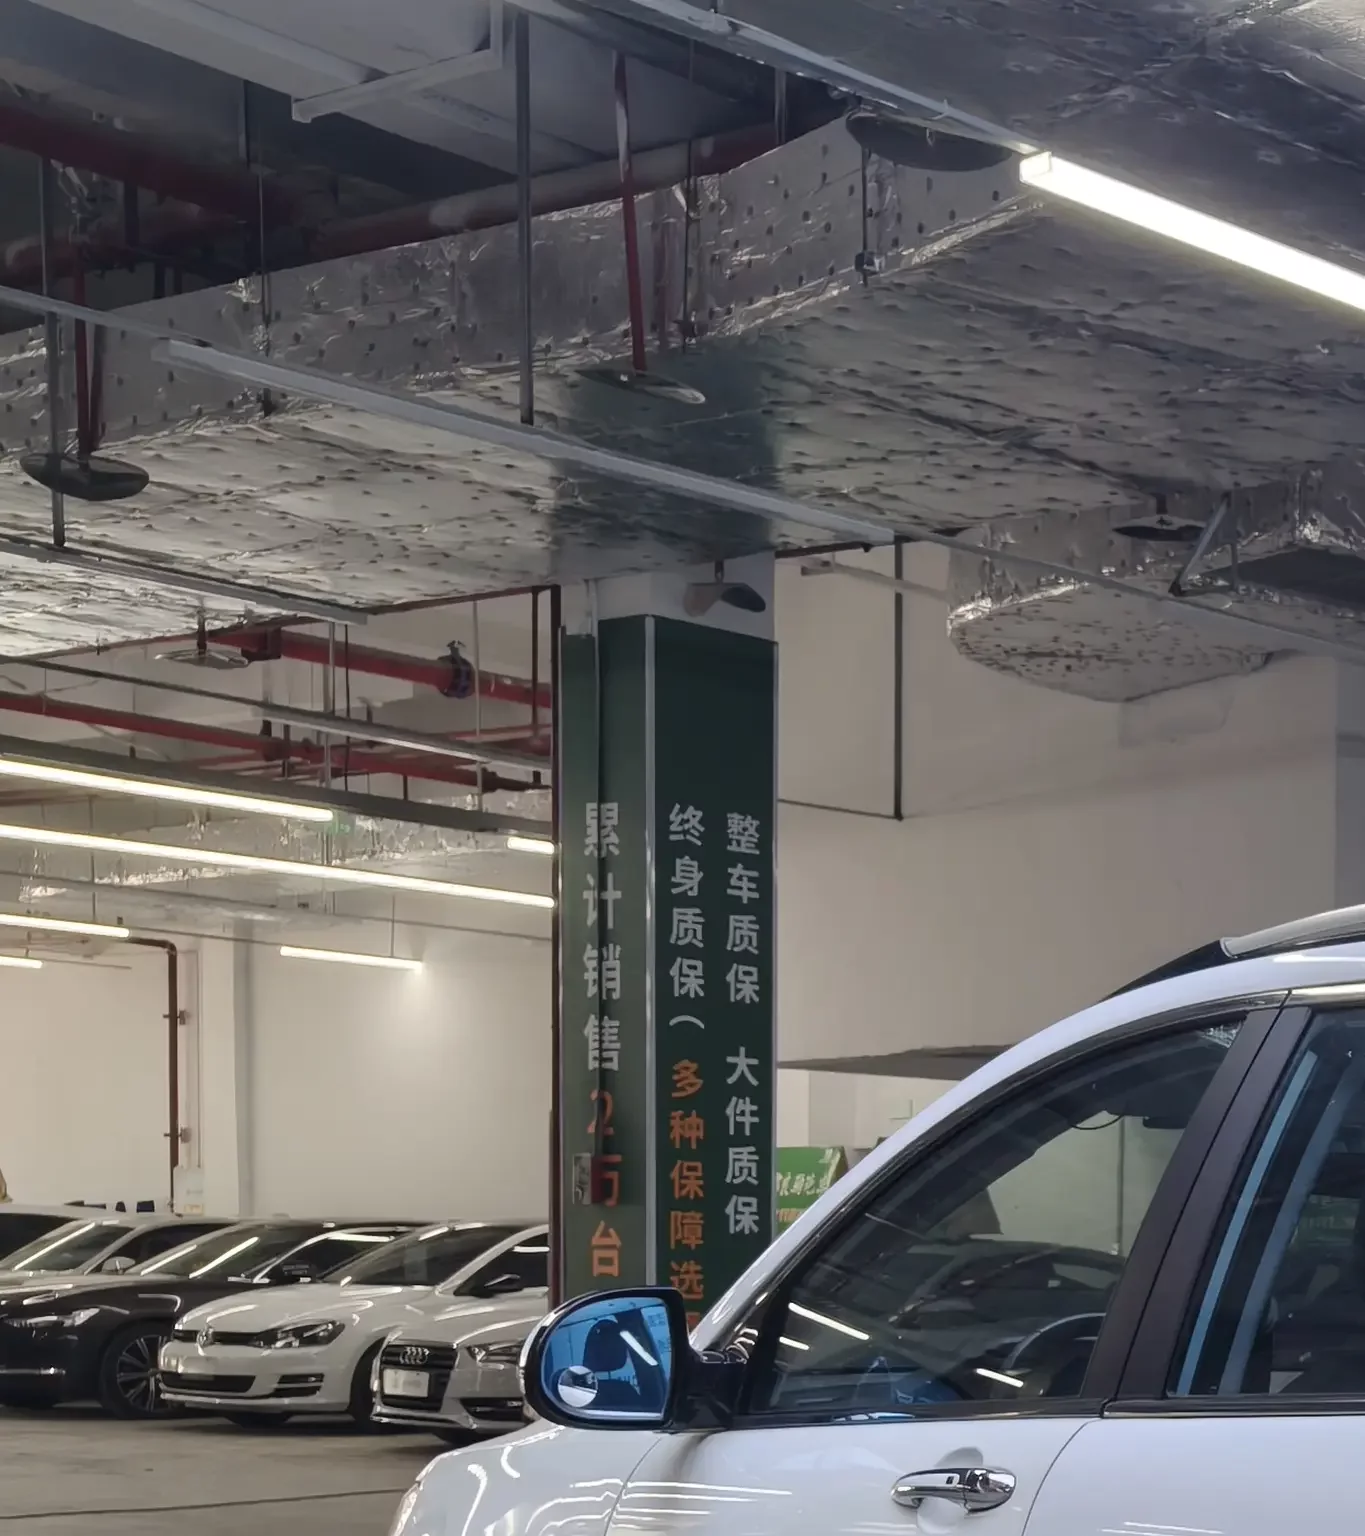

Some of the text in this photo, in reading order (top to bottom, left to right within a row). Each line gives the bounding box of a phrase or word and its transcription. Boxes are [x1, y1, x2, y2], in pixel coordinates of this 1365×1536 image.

[669, 803, 705, 1330] 终身质保(多种保障选
[725, 812, 760, 1236] 整车质保 大件质保
